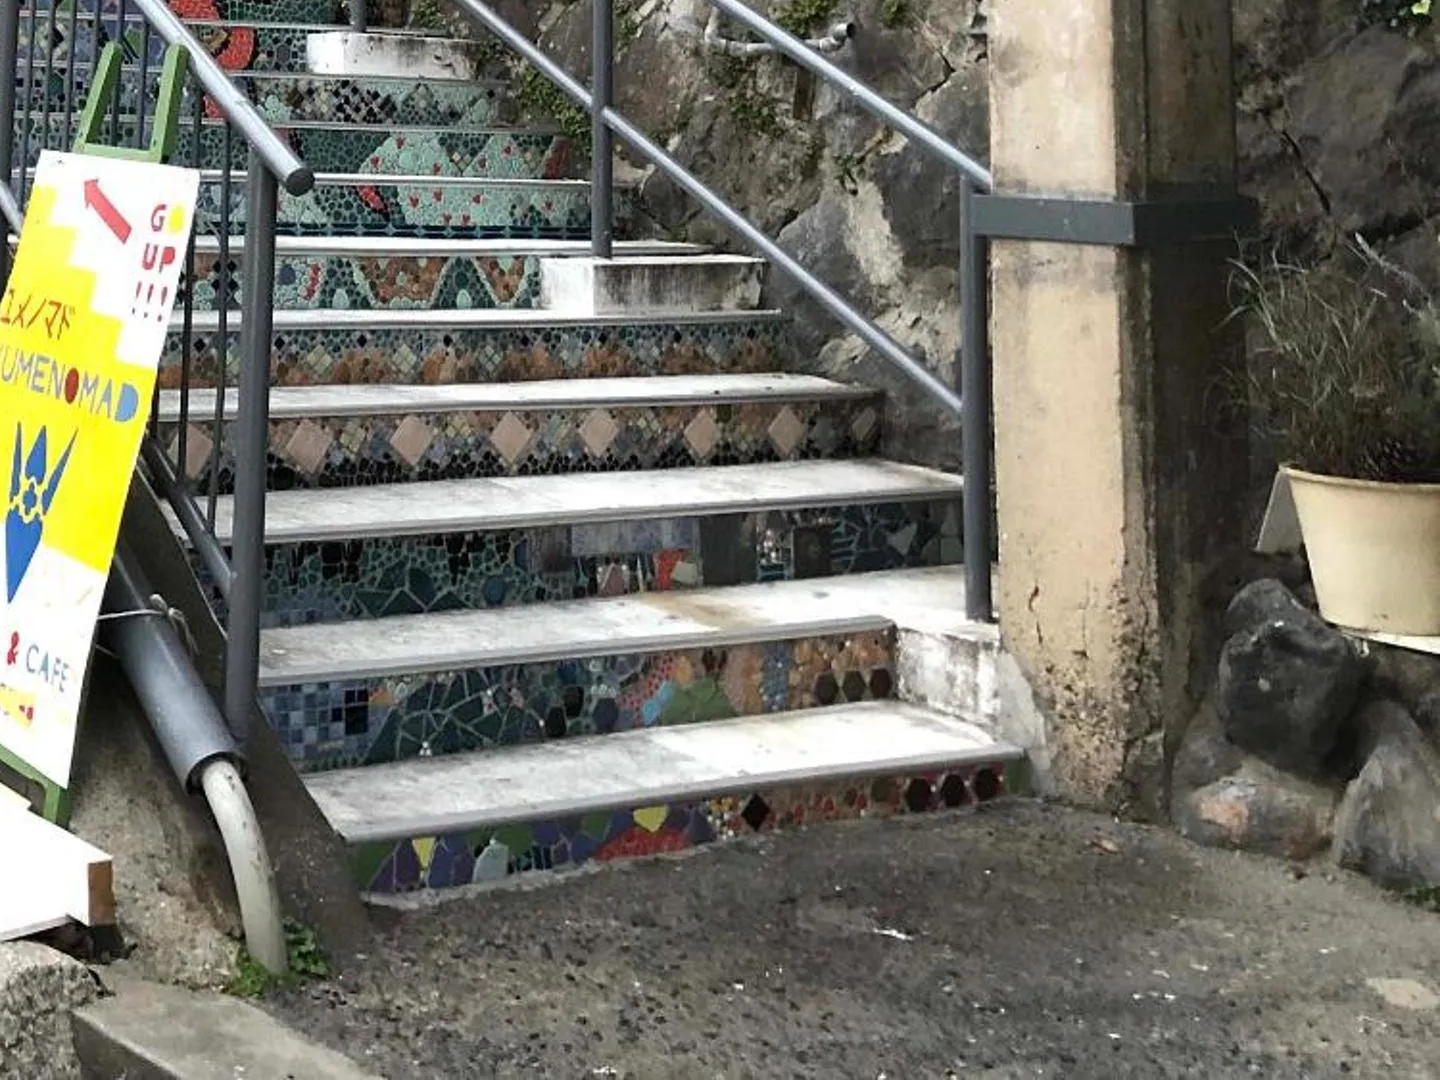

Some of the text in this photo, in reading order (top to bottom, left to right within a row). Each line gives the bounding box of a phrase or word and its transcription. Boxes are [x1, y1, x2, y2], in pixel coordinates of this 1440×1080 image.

[150, 203, 185, 234] GO
[141, 243, 176, 272] UP
[7, 631, 20, 665] &
[26, 644, 69, 693] CAFE
